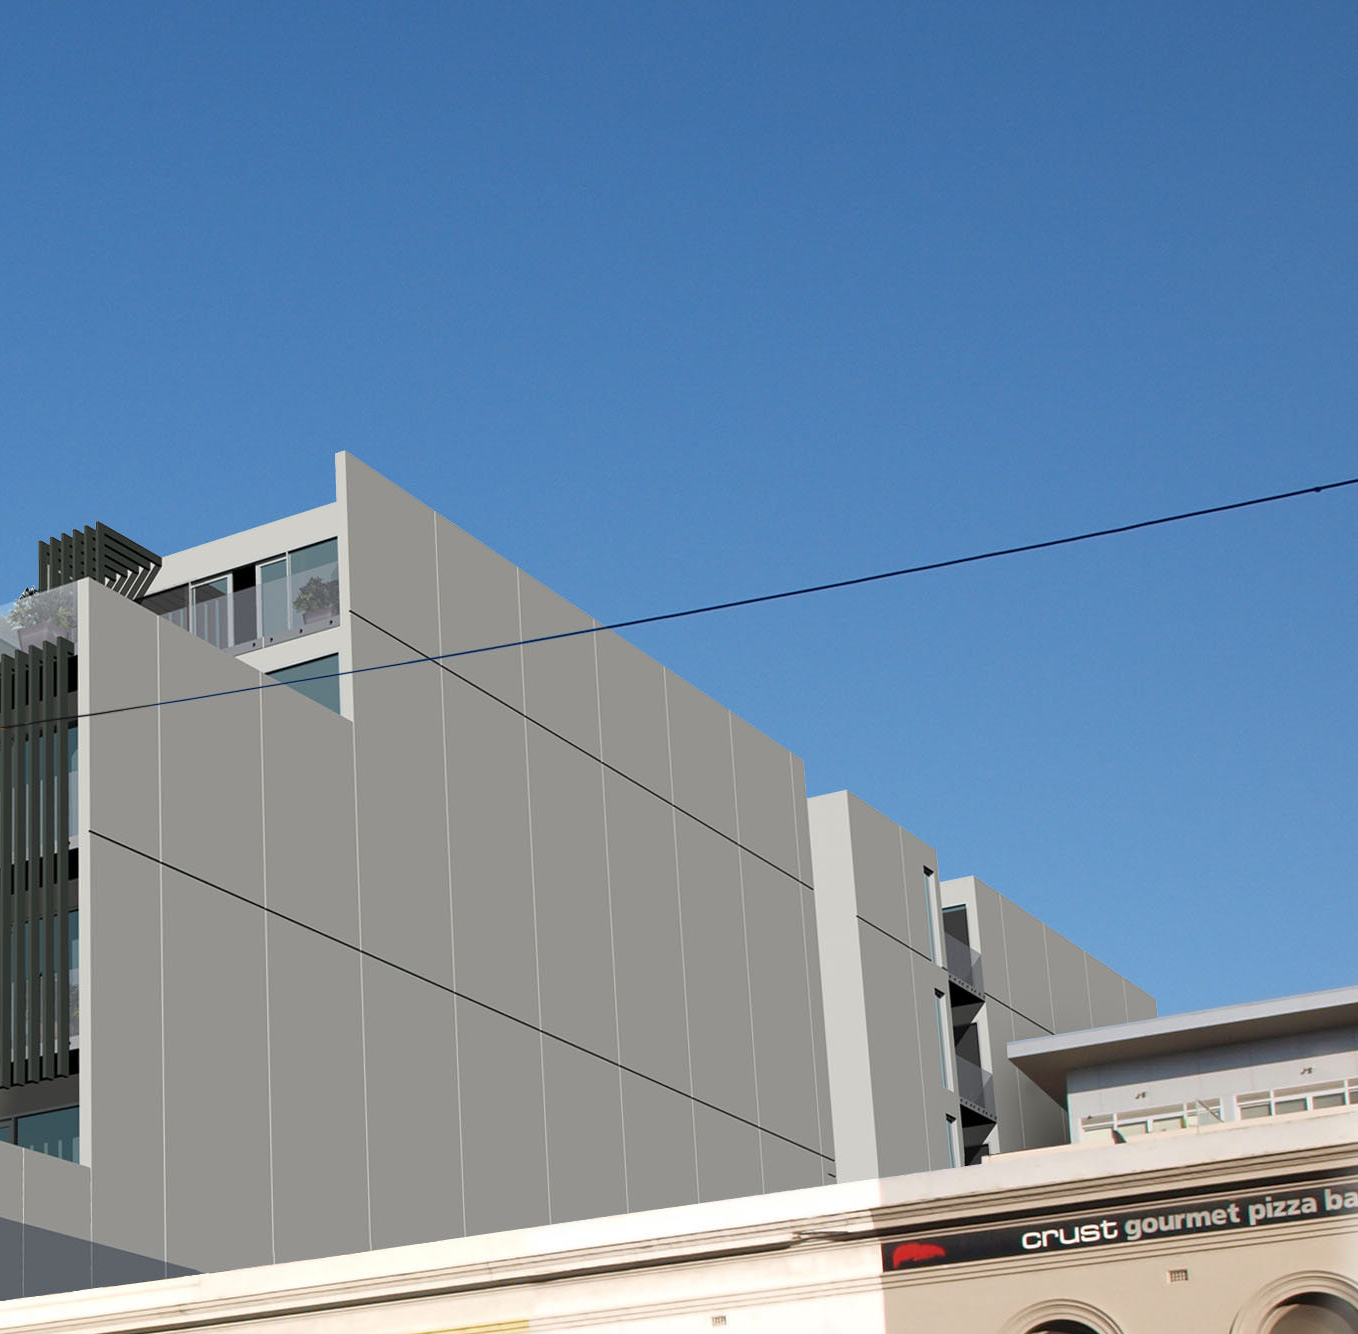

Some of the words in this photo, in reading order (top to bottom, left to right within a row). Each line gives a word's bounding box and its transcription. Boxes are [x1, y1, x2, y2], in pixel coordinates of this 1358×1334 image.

[1021, 1219, 1118, 1250] crust
[1124, 1202, 1241, 1240] gourmet
[1248, 1195, 1317, 1226] pizza
